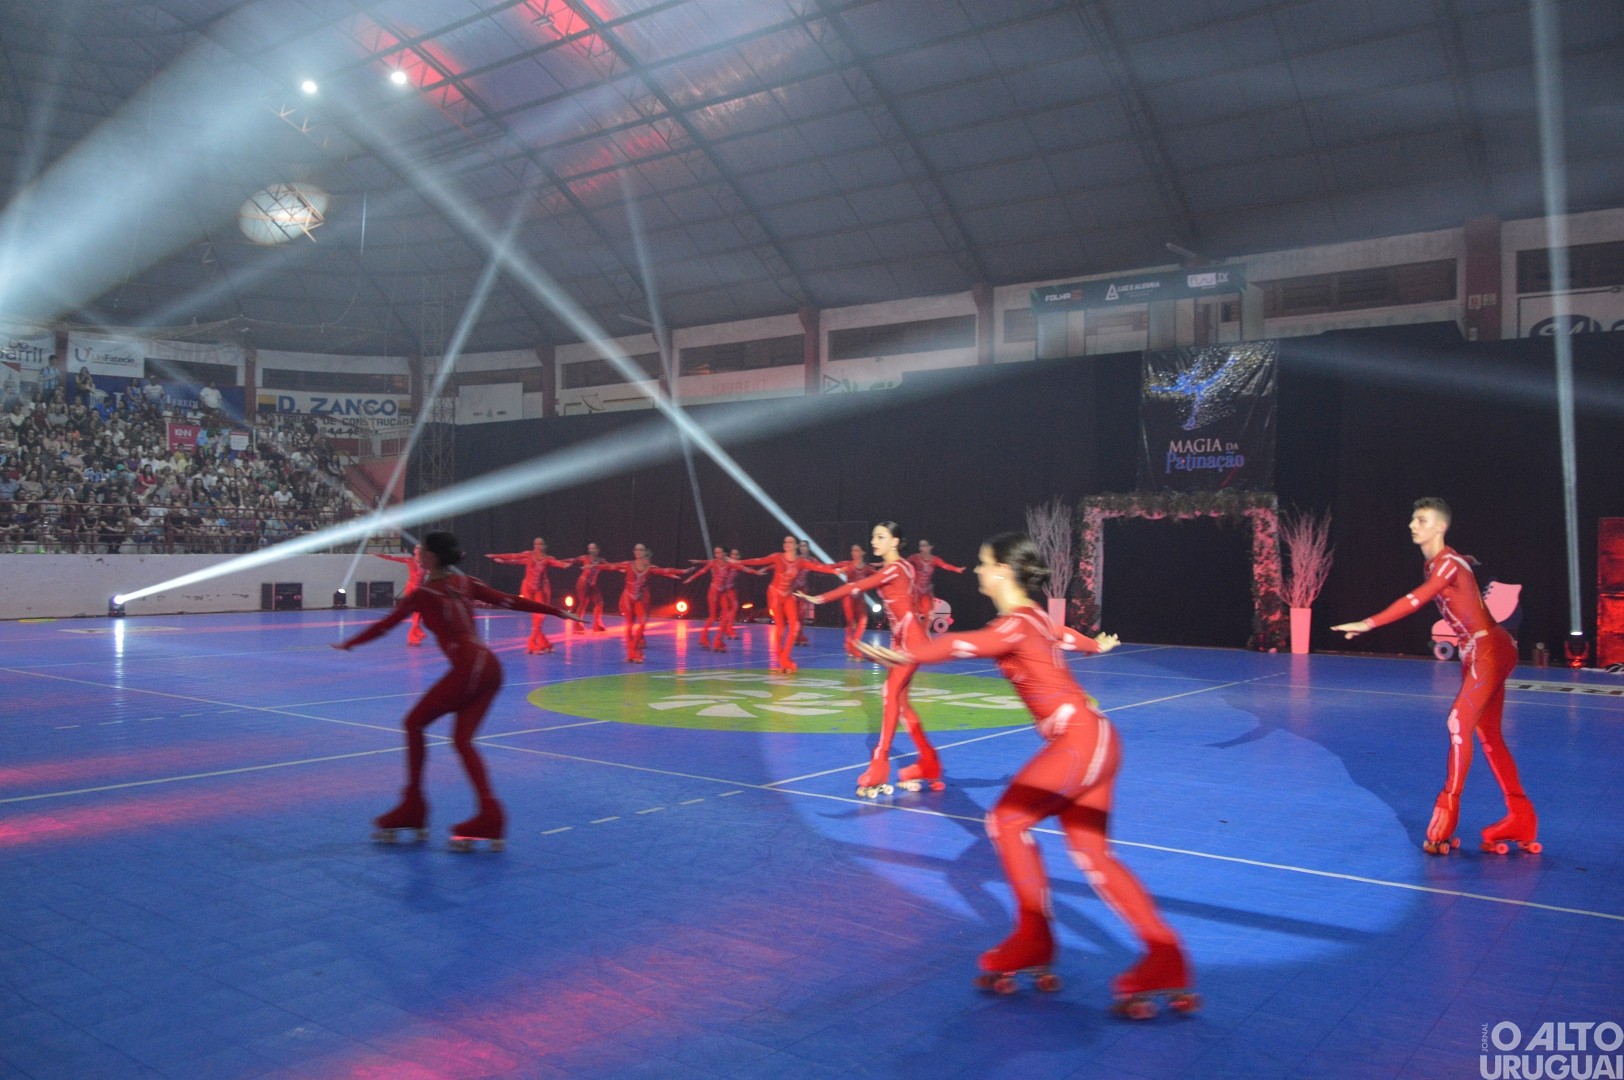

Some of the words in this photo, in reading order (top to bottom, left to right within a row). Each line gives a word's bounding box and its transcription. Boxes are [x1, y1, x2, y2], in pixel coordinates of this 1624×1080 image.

[310, 396, 397, 416] ZANCO
[1169, 438, 1222, 453] MAGIA
[1225, 442, 1239, 450] DA
[1165, 450, 1245, 473] Patinação
